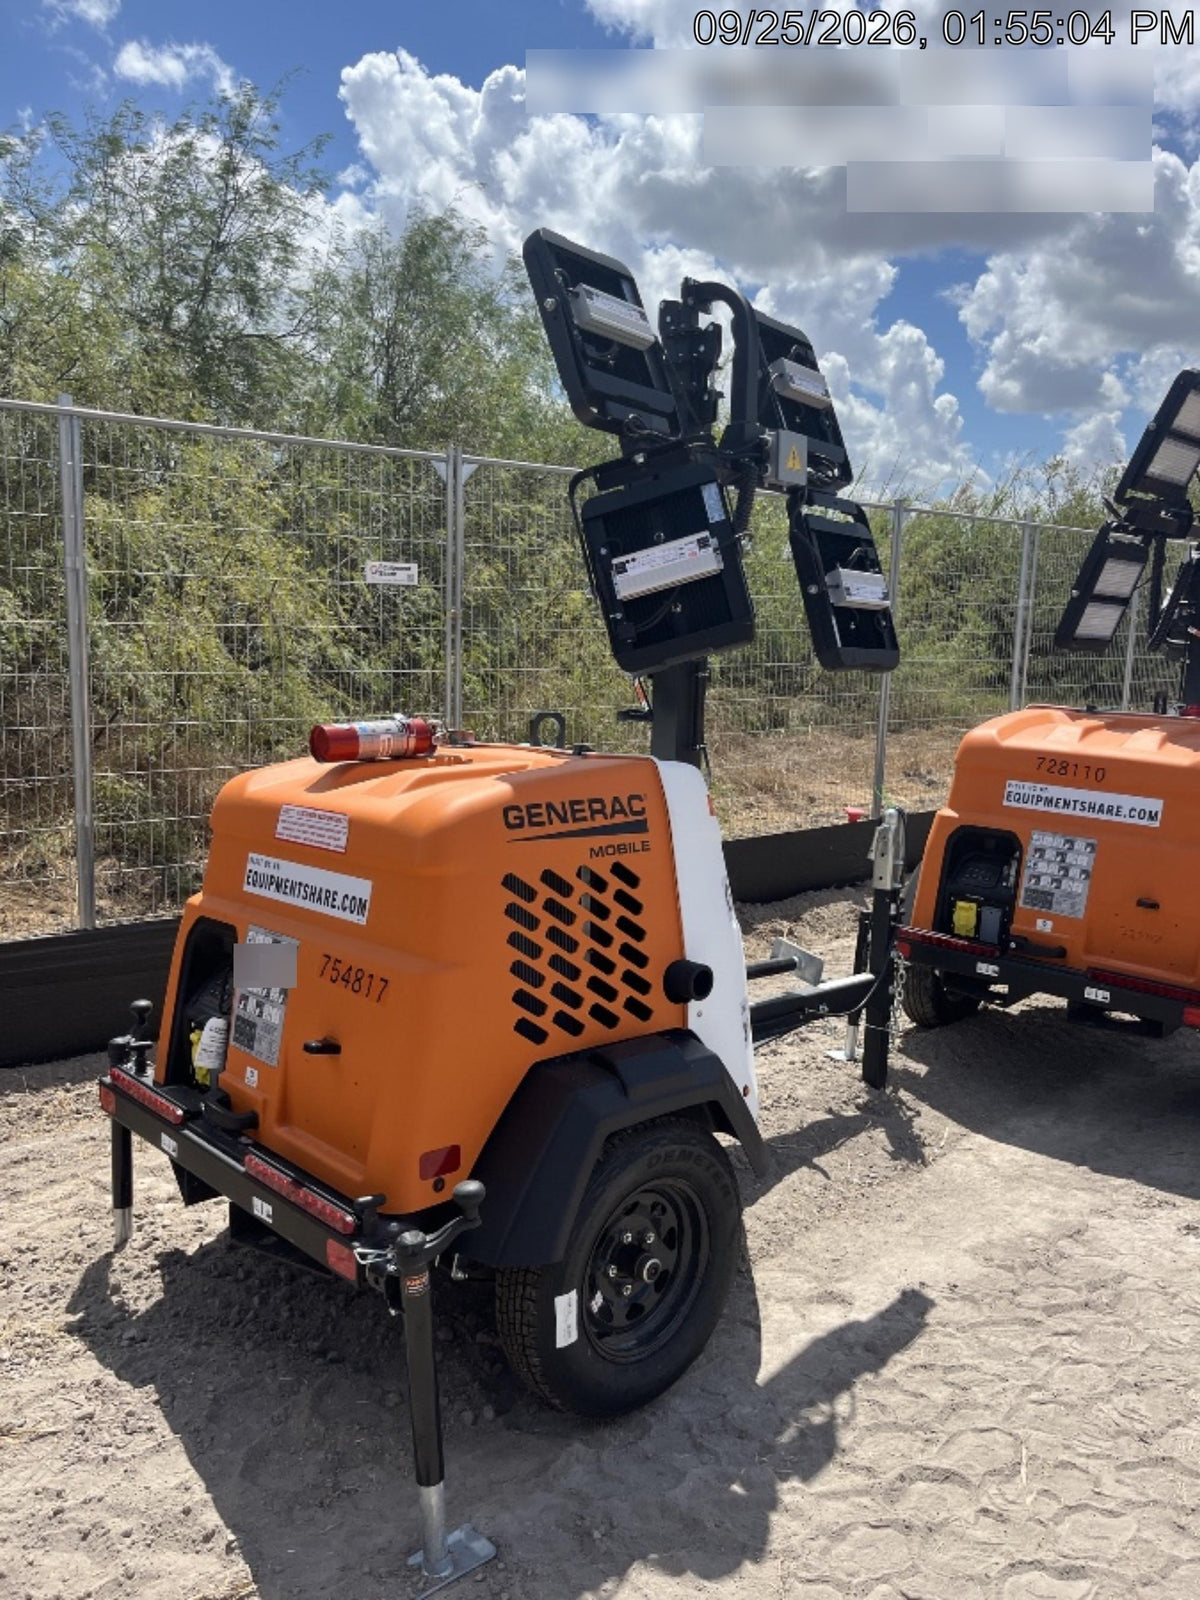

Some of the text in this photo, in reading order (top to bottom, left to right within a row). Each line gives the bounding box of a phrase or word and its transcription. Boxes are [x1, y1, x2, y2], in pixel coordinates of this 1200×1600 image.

[1036, 756, 1107, 783] 728110
[502, 794, 647, 830] GENERAC
[1005, 790, 1160, 823] EQUIPMENTSHARE.COM
[589, 840, 651, 859] MOBILE
[246, 868, 369, 918] EQUIPMENTSHARE.COM
[319, 953, 389, 1004] 754817
